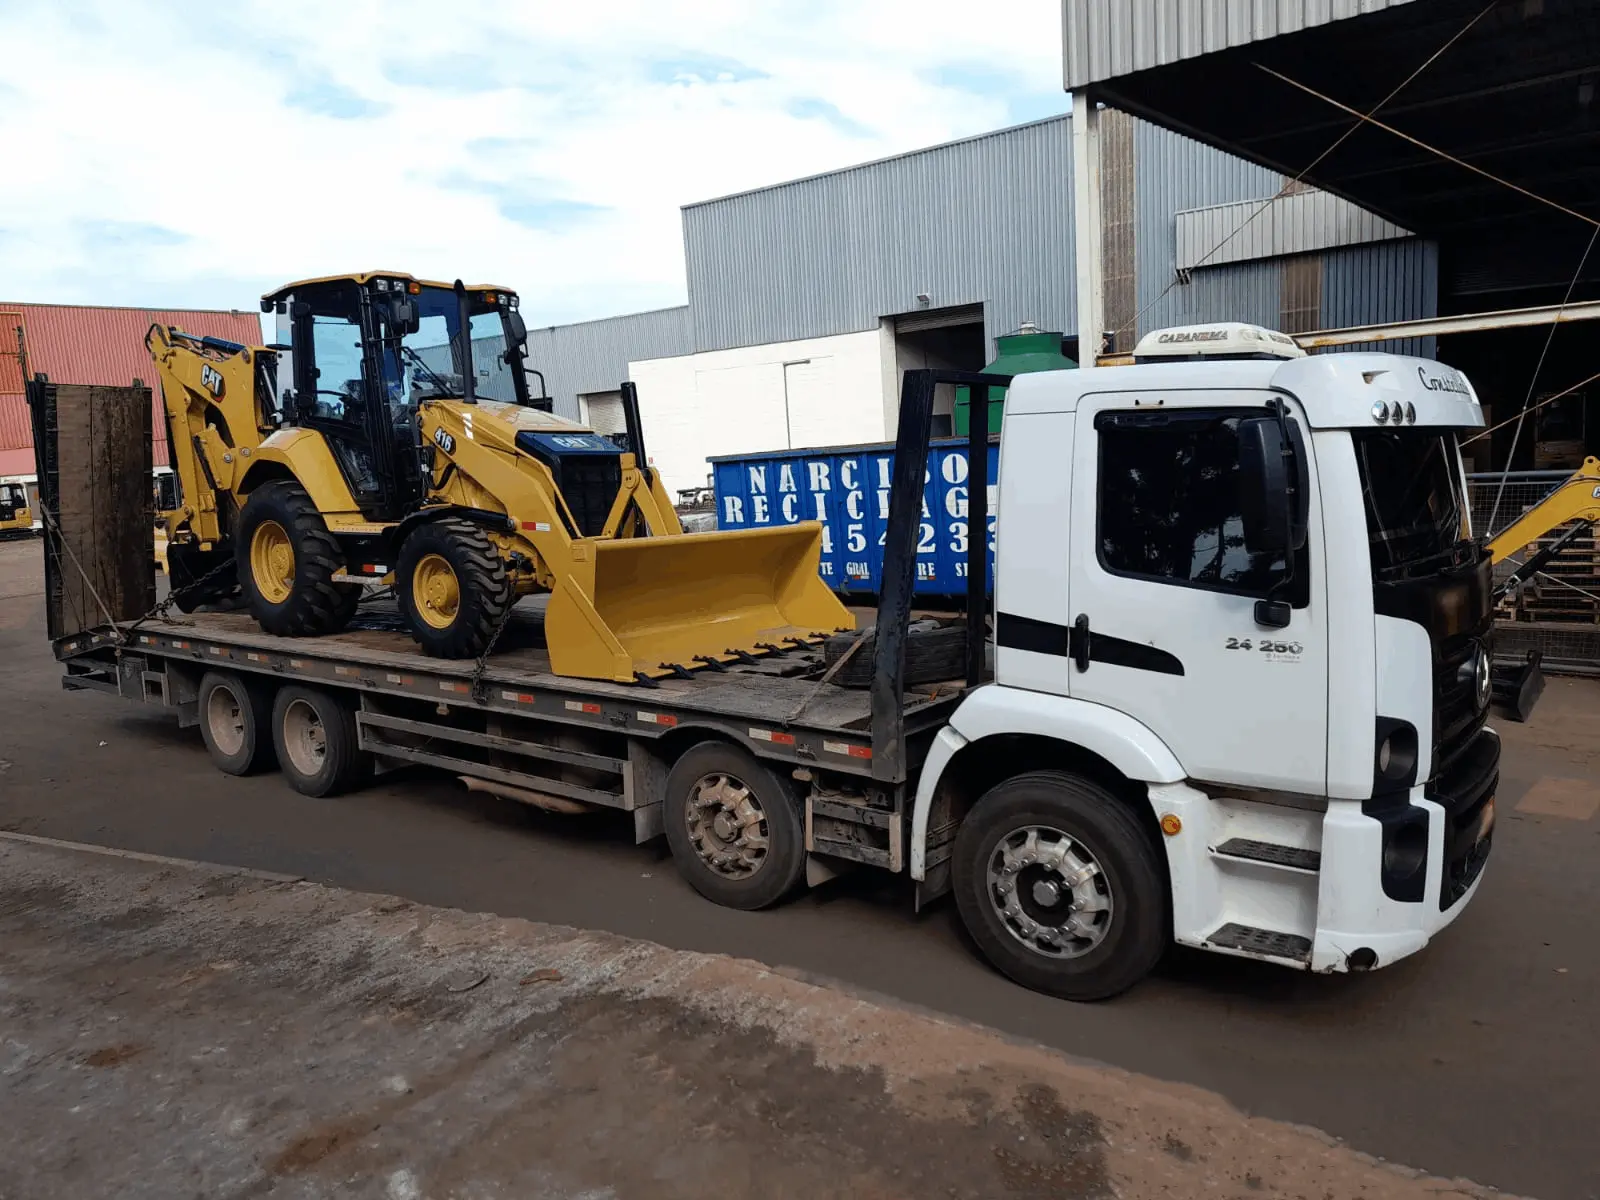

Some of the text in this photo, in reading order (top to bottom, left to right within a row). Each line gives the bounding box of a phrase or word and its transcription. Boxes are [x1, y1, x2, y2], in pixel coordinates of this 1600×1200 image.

[202, 363, 223, 394] CAT
[434, 427, 453, 452] 416
[552, 437, 591, 448] CAT
[1225, 637, 1304, 655] 24 250
